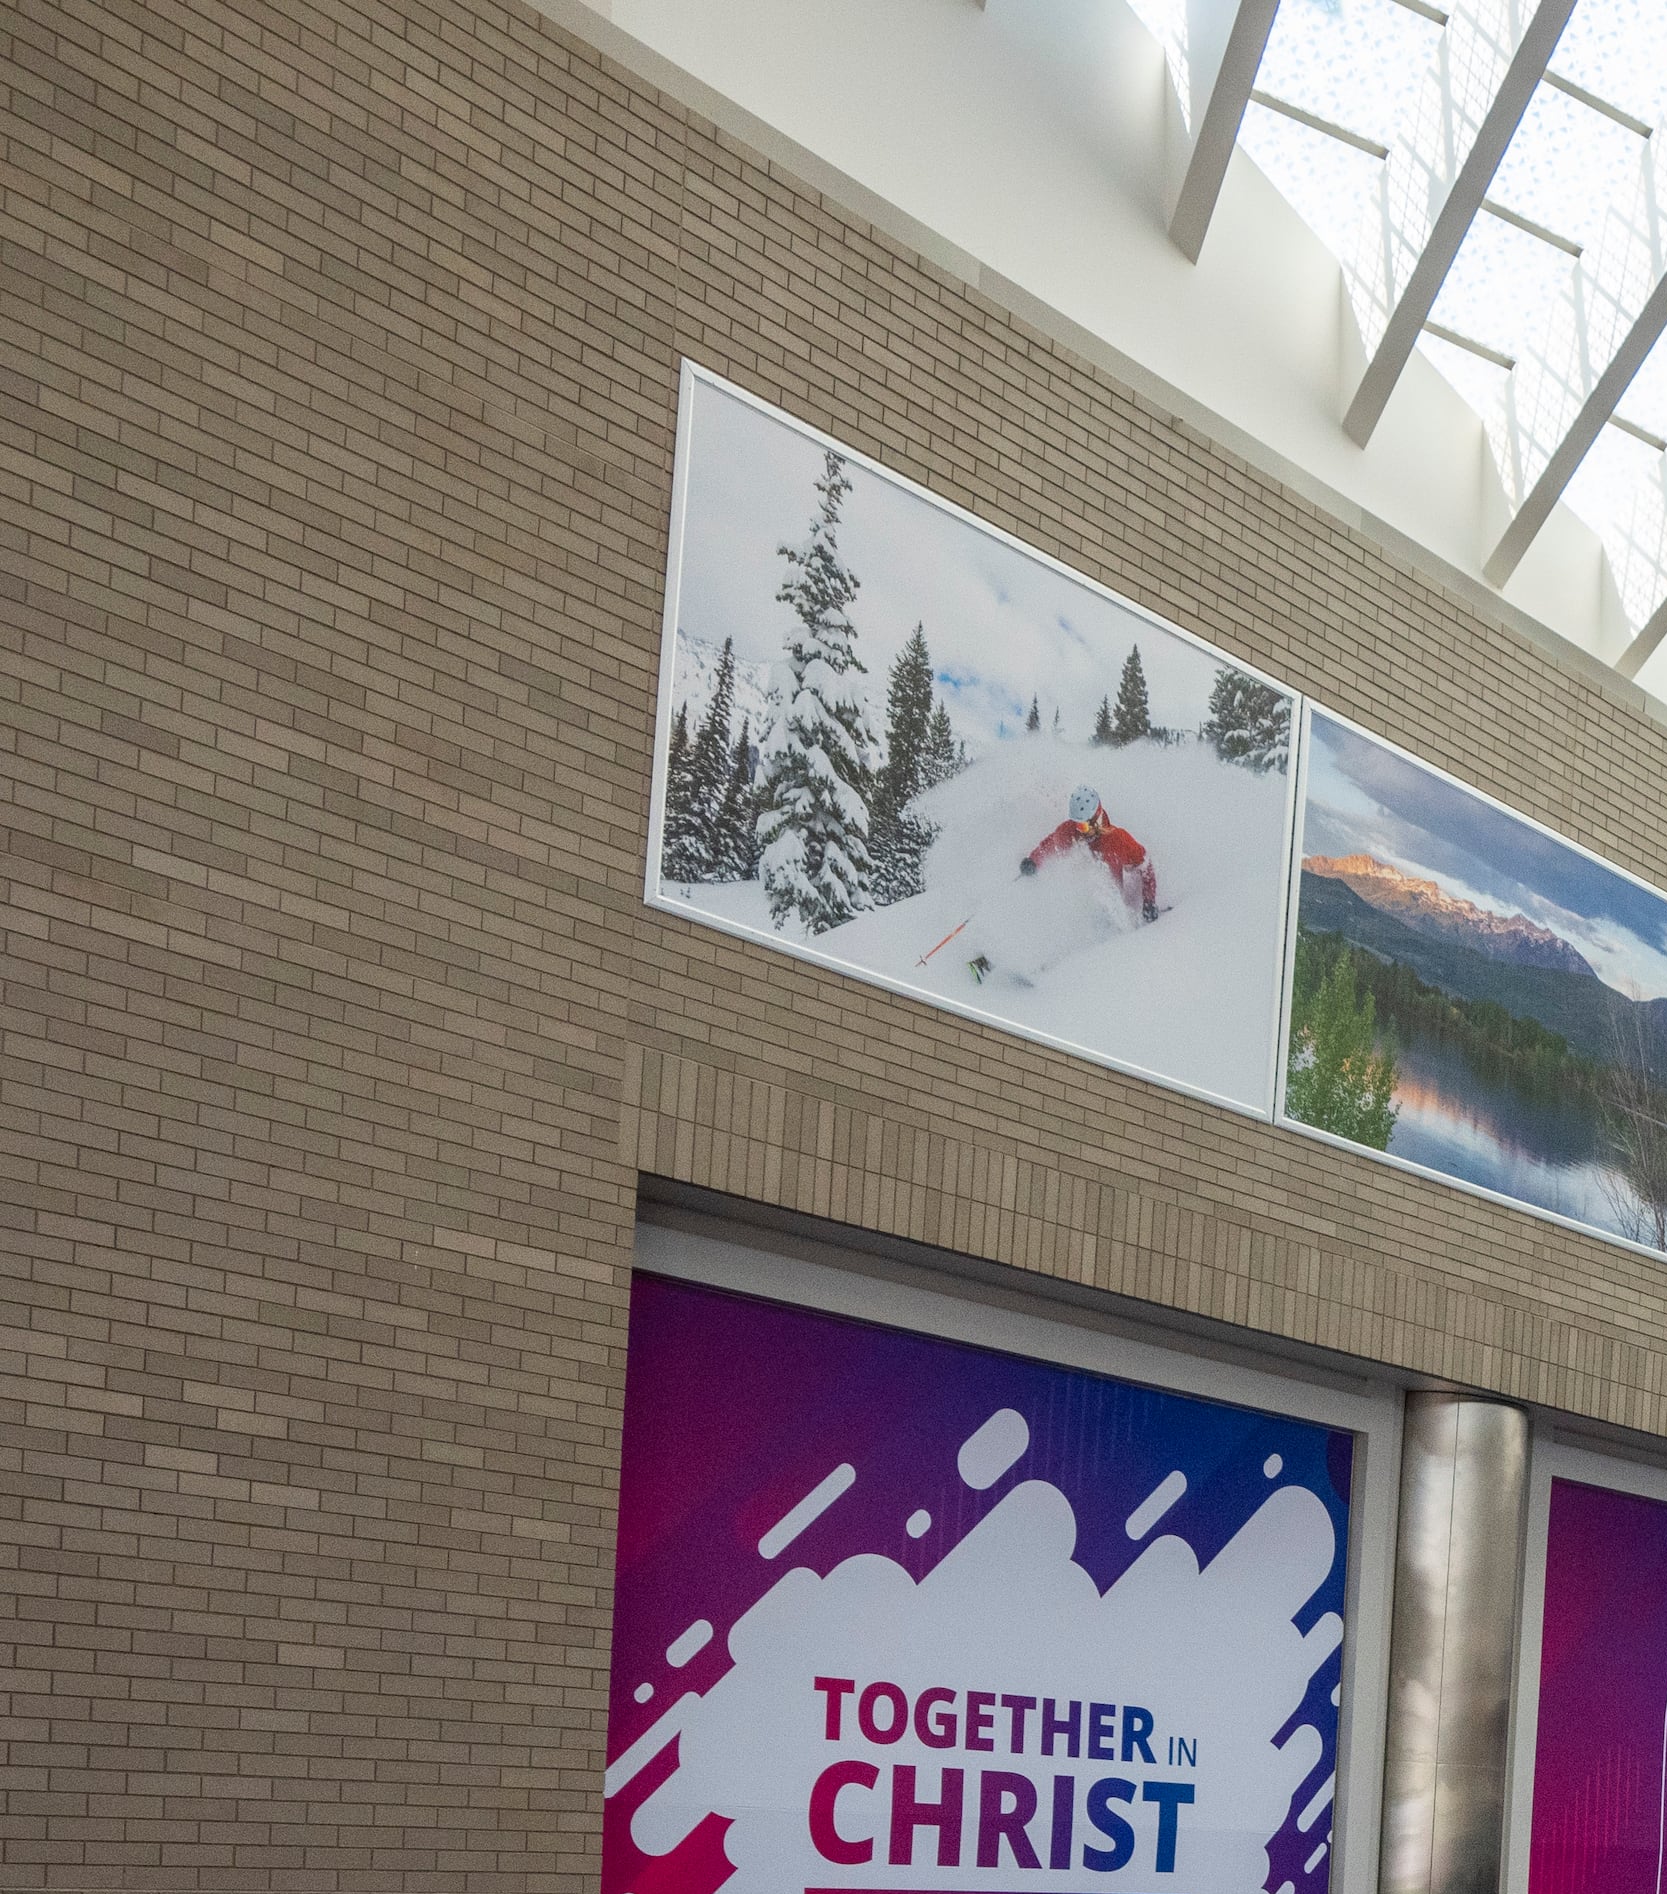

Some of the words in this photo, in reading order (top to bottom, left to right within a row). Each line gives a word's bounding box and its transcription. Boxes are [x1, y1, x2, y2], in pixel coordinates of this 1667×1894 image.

[814, 1676, 1157, 1765] TOGETHER
[1169, 1737, 1197, 1767] IN
[809, 1760, 1195, 1874] CHRIST
